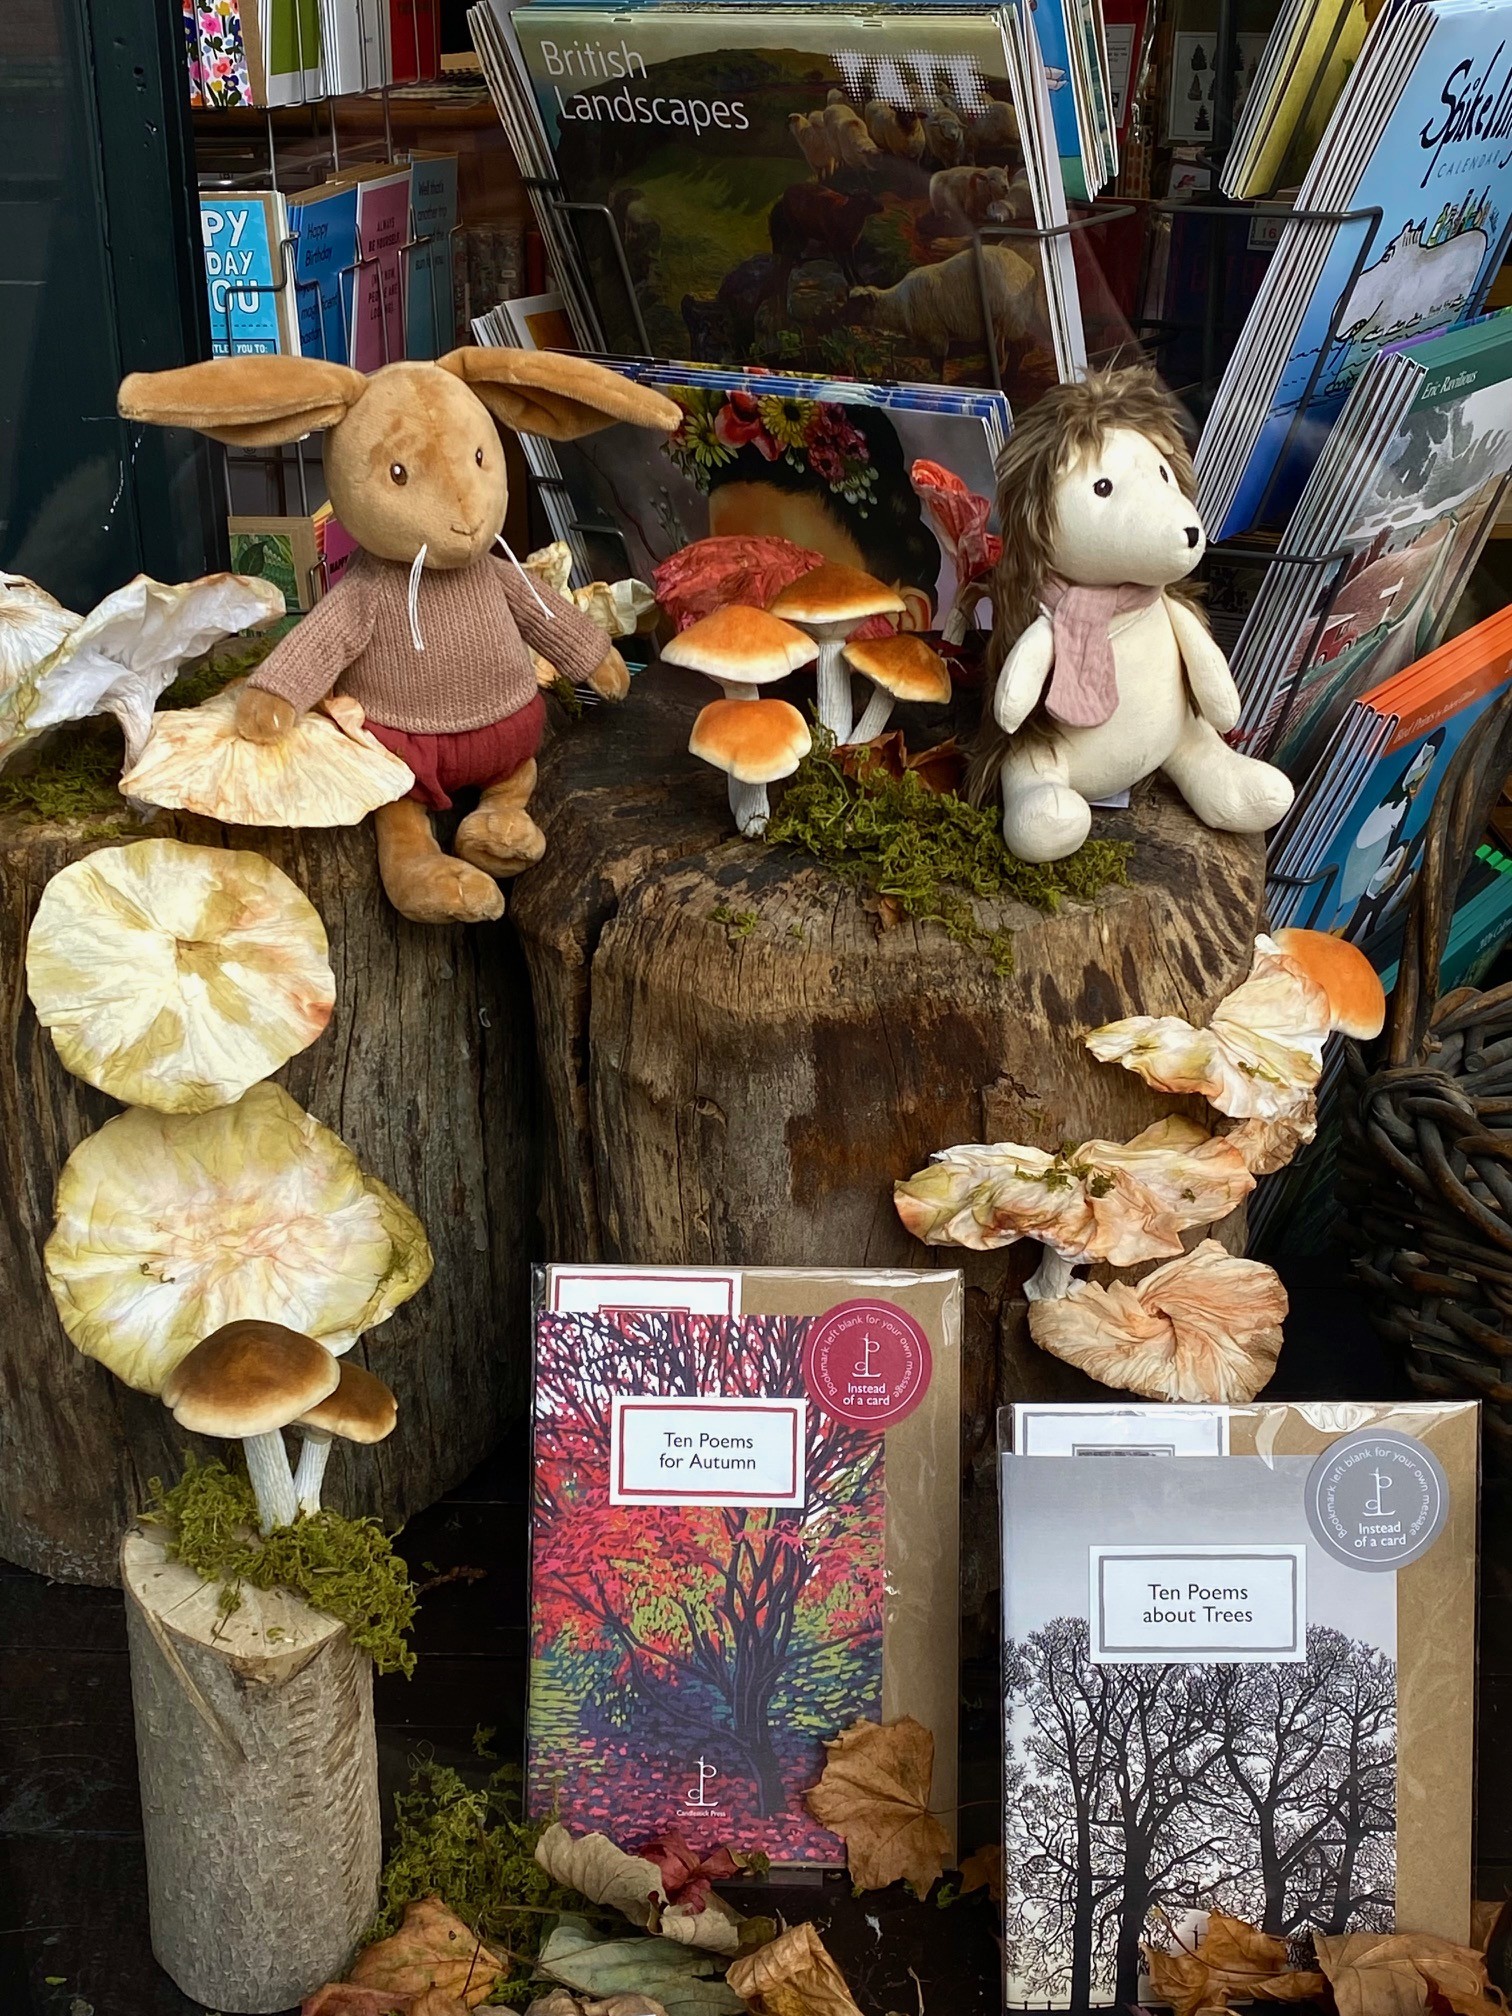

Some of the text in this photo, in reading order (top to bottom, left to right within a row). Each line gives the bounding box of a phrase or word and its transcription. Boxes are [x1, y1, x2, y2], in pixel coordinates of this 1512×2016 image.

[540, 39, 648, 79] British
[554, 85, 749, 136] Landscapes
[1437, 149, 1500, 178] CALENDAR
[207, 278, 260, 314] OU
[1421, 381, 1441, 400] Eric
[820, 1313, 914, 1398] Bookmark left blank for your own message
[848, 1382, 886, 1394] Instead
[843, 1395, 890, 1406] of a card
[664, 1432, 754, 1450] Ten Poems
[659, 1452, 757, 1471] for Autumn
[1327, 1446, 1430, 1539] Bookmark left blank for your own message
[1359, 1521, 1401, 1535] Instead
[1354, 1533, 1407, 1548] of a card
[1147, 1583, 1249, 1601] Ten Poems
[1142, 1606, 1254, 1624] about Trees
